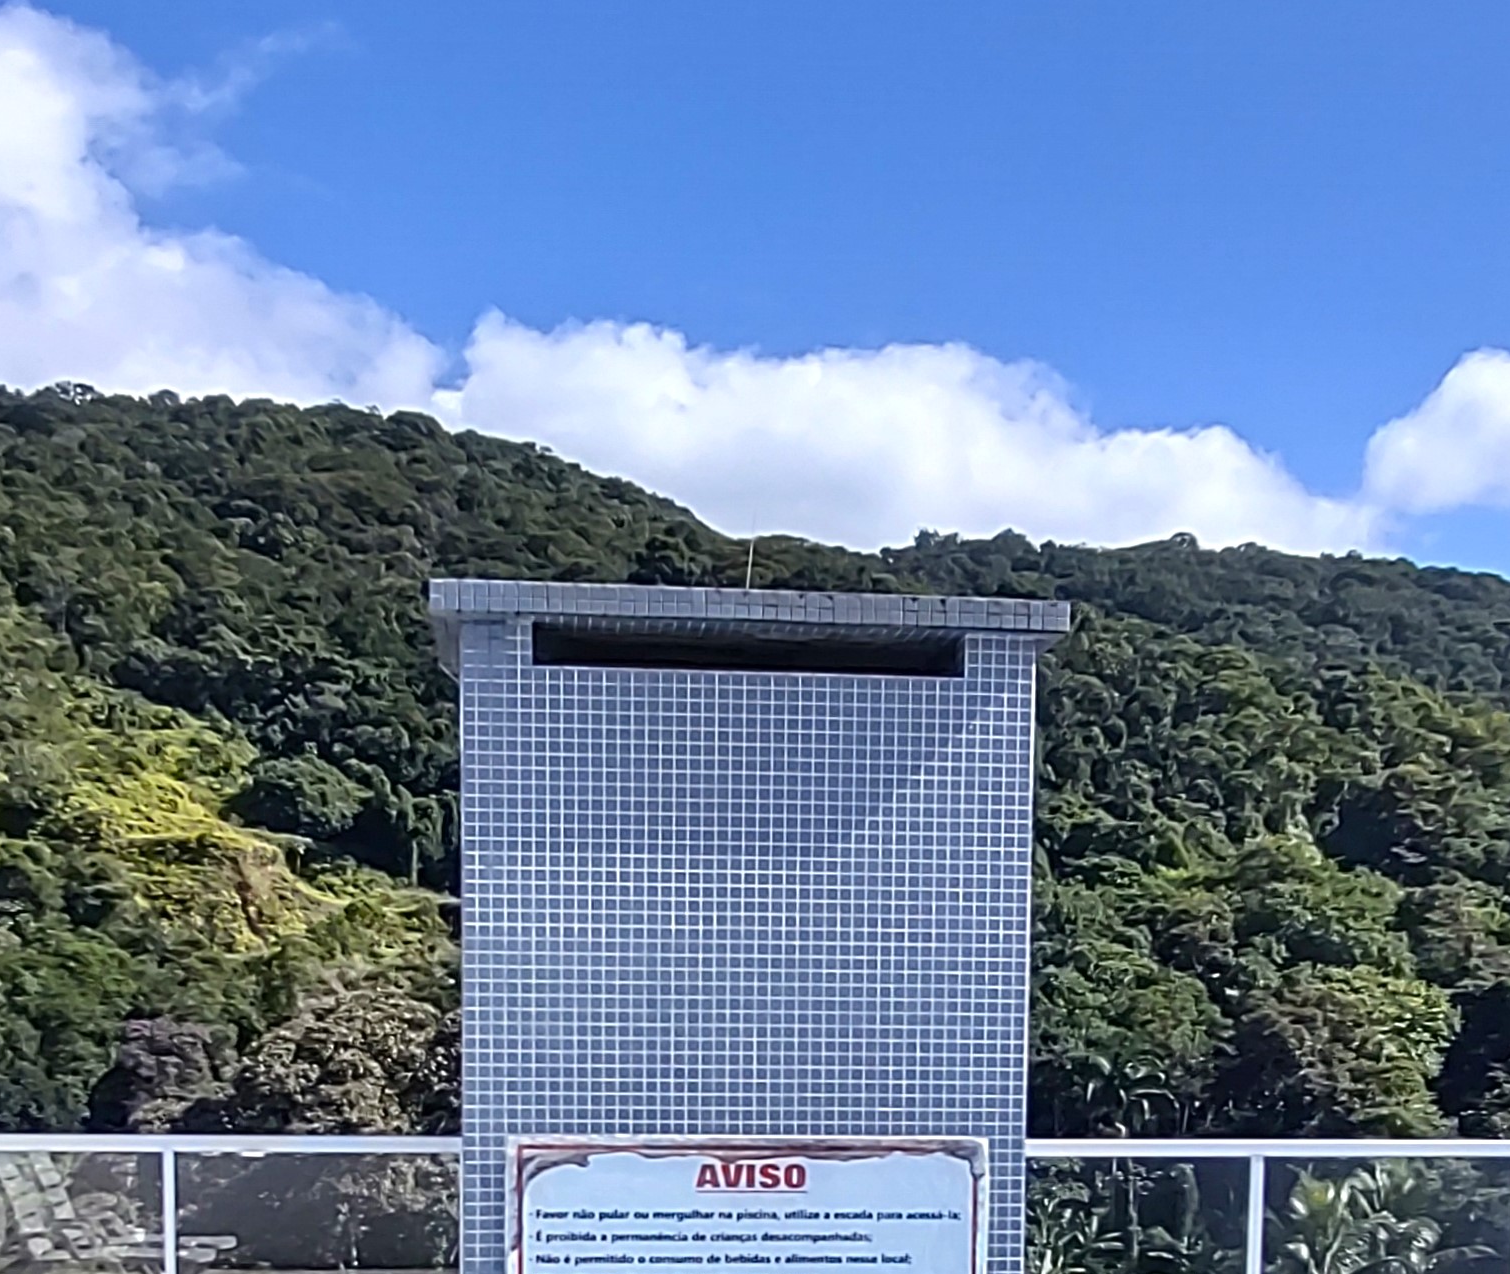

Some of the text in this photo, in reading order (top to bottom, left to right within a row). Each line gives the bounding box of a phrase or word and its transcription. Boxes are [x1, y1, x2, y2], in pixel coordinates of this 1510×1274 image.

[696, 1163, 807, 1188] AVISO
[536, 1209, 569, 1219] Favor
[573, 1209, 595, 1219] não
[599, 1209, 630, 1221] pular
[634, 1211, 649, 1219] ou
[653, 1209, 715, 1221] mergulhar
[719, 1211, 733, 1219] na
[737, 1209, 780, 1221] piscina,
[785, 1209, 820, 1219] utilize
[834, 1209, 873, 1219] escada
[877, 1211, 903, 1222] para
[546, 1231, 597, 1243] proibida
[611, 1231, 688, 1243] permanência
[692, 1231, 706, 1241] de
[710, 1231, 757, 1243] crianças
[536, 1254, 560, 1263] Não
[574, 1254, 634, 1266] permitido
[707, 1254, 721, 1263] de
[725, 1254, 771, 1263] bebidas
[785, 1254, 842, 1263] alimentos
[882, 1254, 912, 1264] local;
